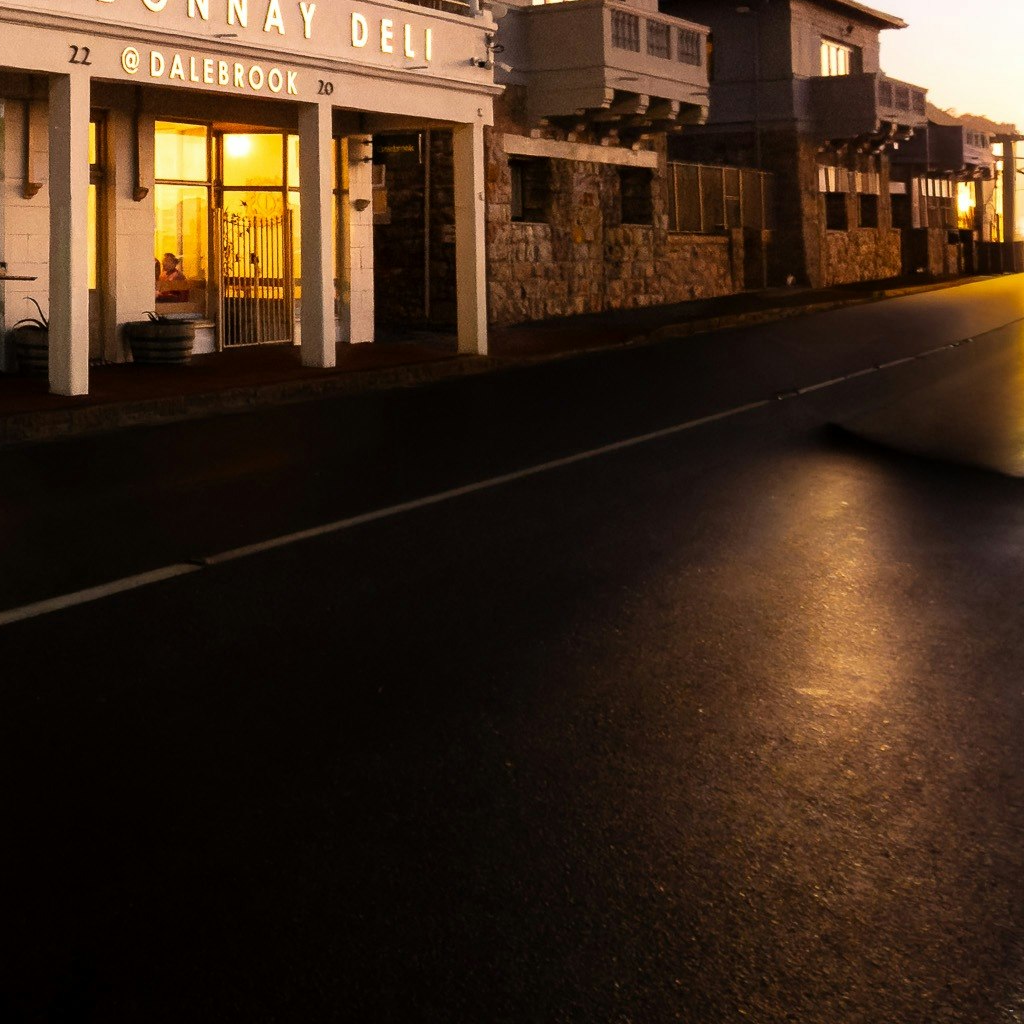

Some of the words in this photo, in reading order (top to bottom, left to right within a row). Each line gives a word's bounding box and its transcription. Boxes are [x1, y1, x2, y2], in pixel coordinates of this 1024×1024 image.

[350, 10, 435, 62] DELI
[68, 44, 92, 66] 22
[121, 46, 141, 74] @
[149, 50, 298, 95] DALEBROOK
[317, 79, 334, 96] 20
